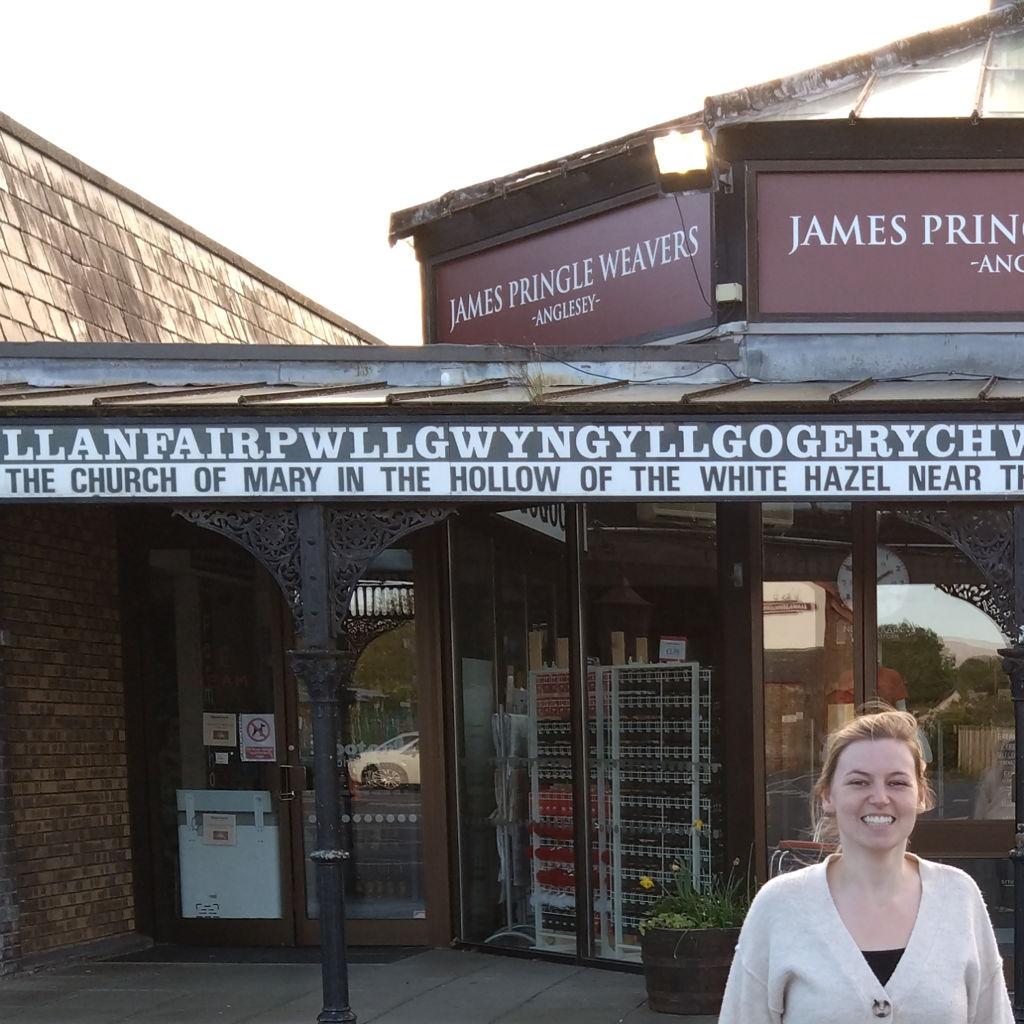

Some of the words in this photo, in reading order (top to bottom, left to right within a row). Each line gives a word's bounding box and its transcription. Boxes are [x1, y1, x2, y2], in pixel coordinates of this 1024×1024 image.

[789, 214, 907, 255] JAMES
[449, 285, 503, 333] JAMES
[509, 258, 593, 308] PRINGLE
[599, 225, 699, 282] WEAVERS
[6, 468, 55, 493] THE
[71, 467, 176, 493] CHURCH
[195, 467, 225, 492] OF
[244, 466, 321, 492] MARY
[338, 466, 363, 492] IN
[381, 466, 430, 491] THE
[450, 466, 560, 492] HOLLOW
[581, 466, 611, 491] OF
[630, 466, 680, 491] THE
[700, 465, 786, 491] WHITE
[805, 465, 890, 491] HAZEL
[909, 465, 980, 491] NEAR
